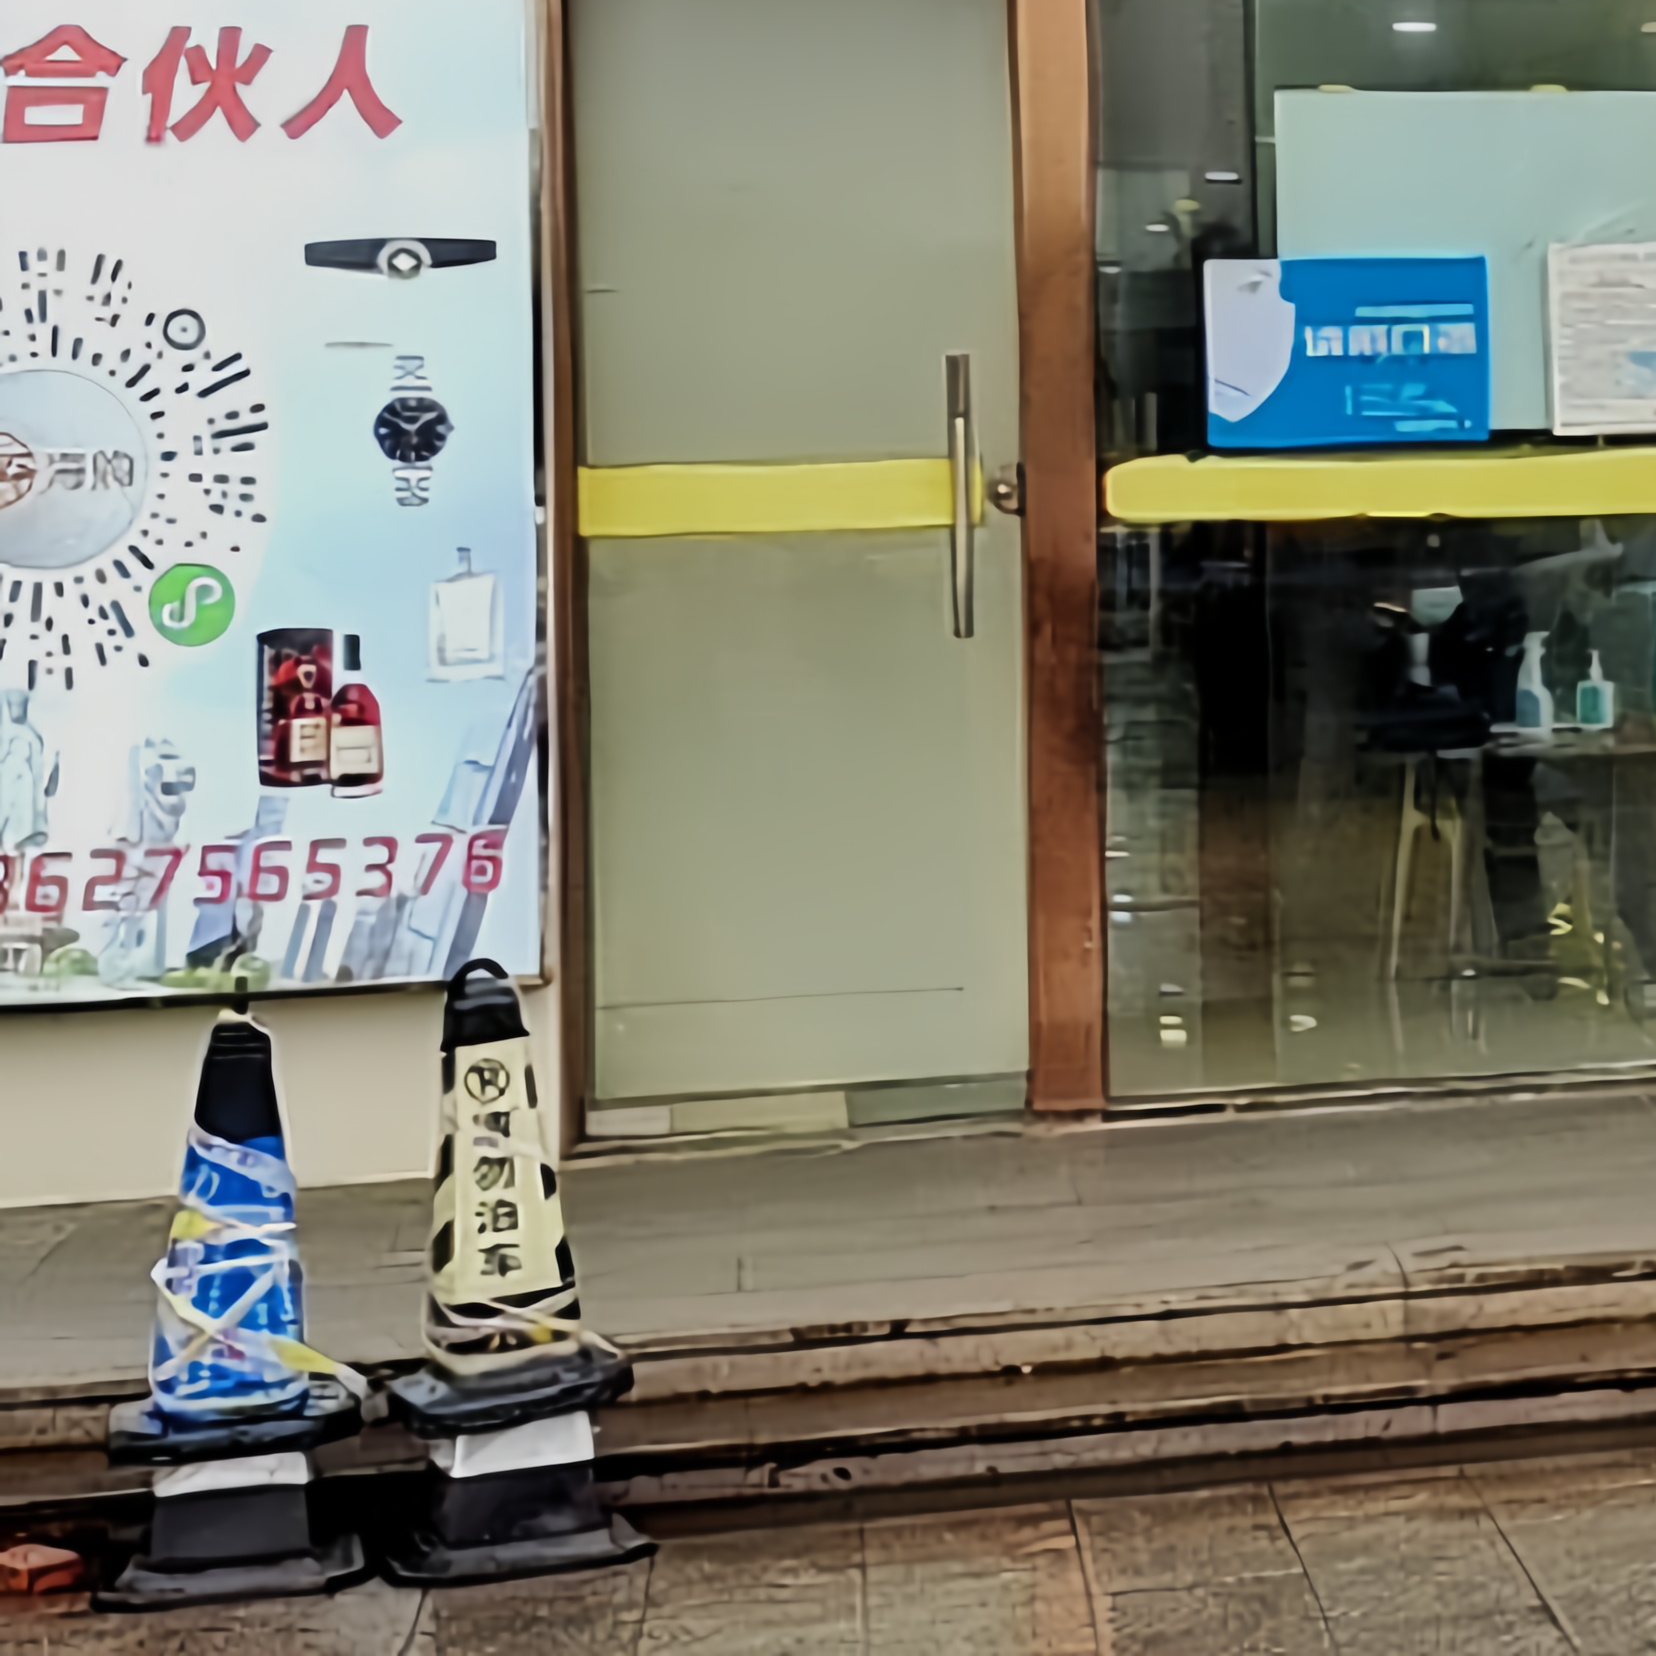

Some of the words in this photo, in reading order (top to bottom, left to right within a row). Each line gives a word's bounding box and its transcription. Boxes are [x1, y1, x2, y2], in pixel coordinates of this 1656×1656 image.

[0, 24, 403, 144] 合伙人
[0, 826, 508, 914] 627565376
